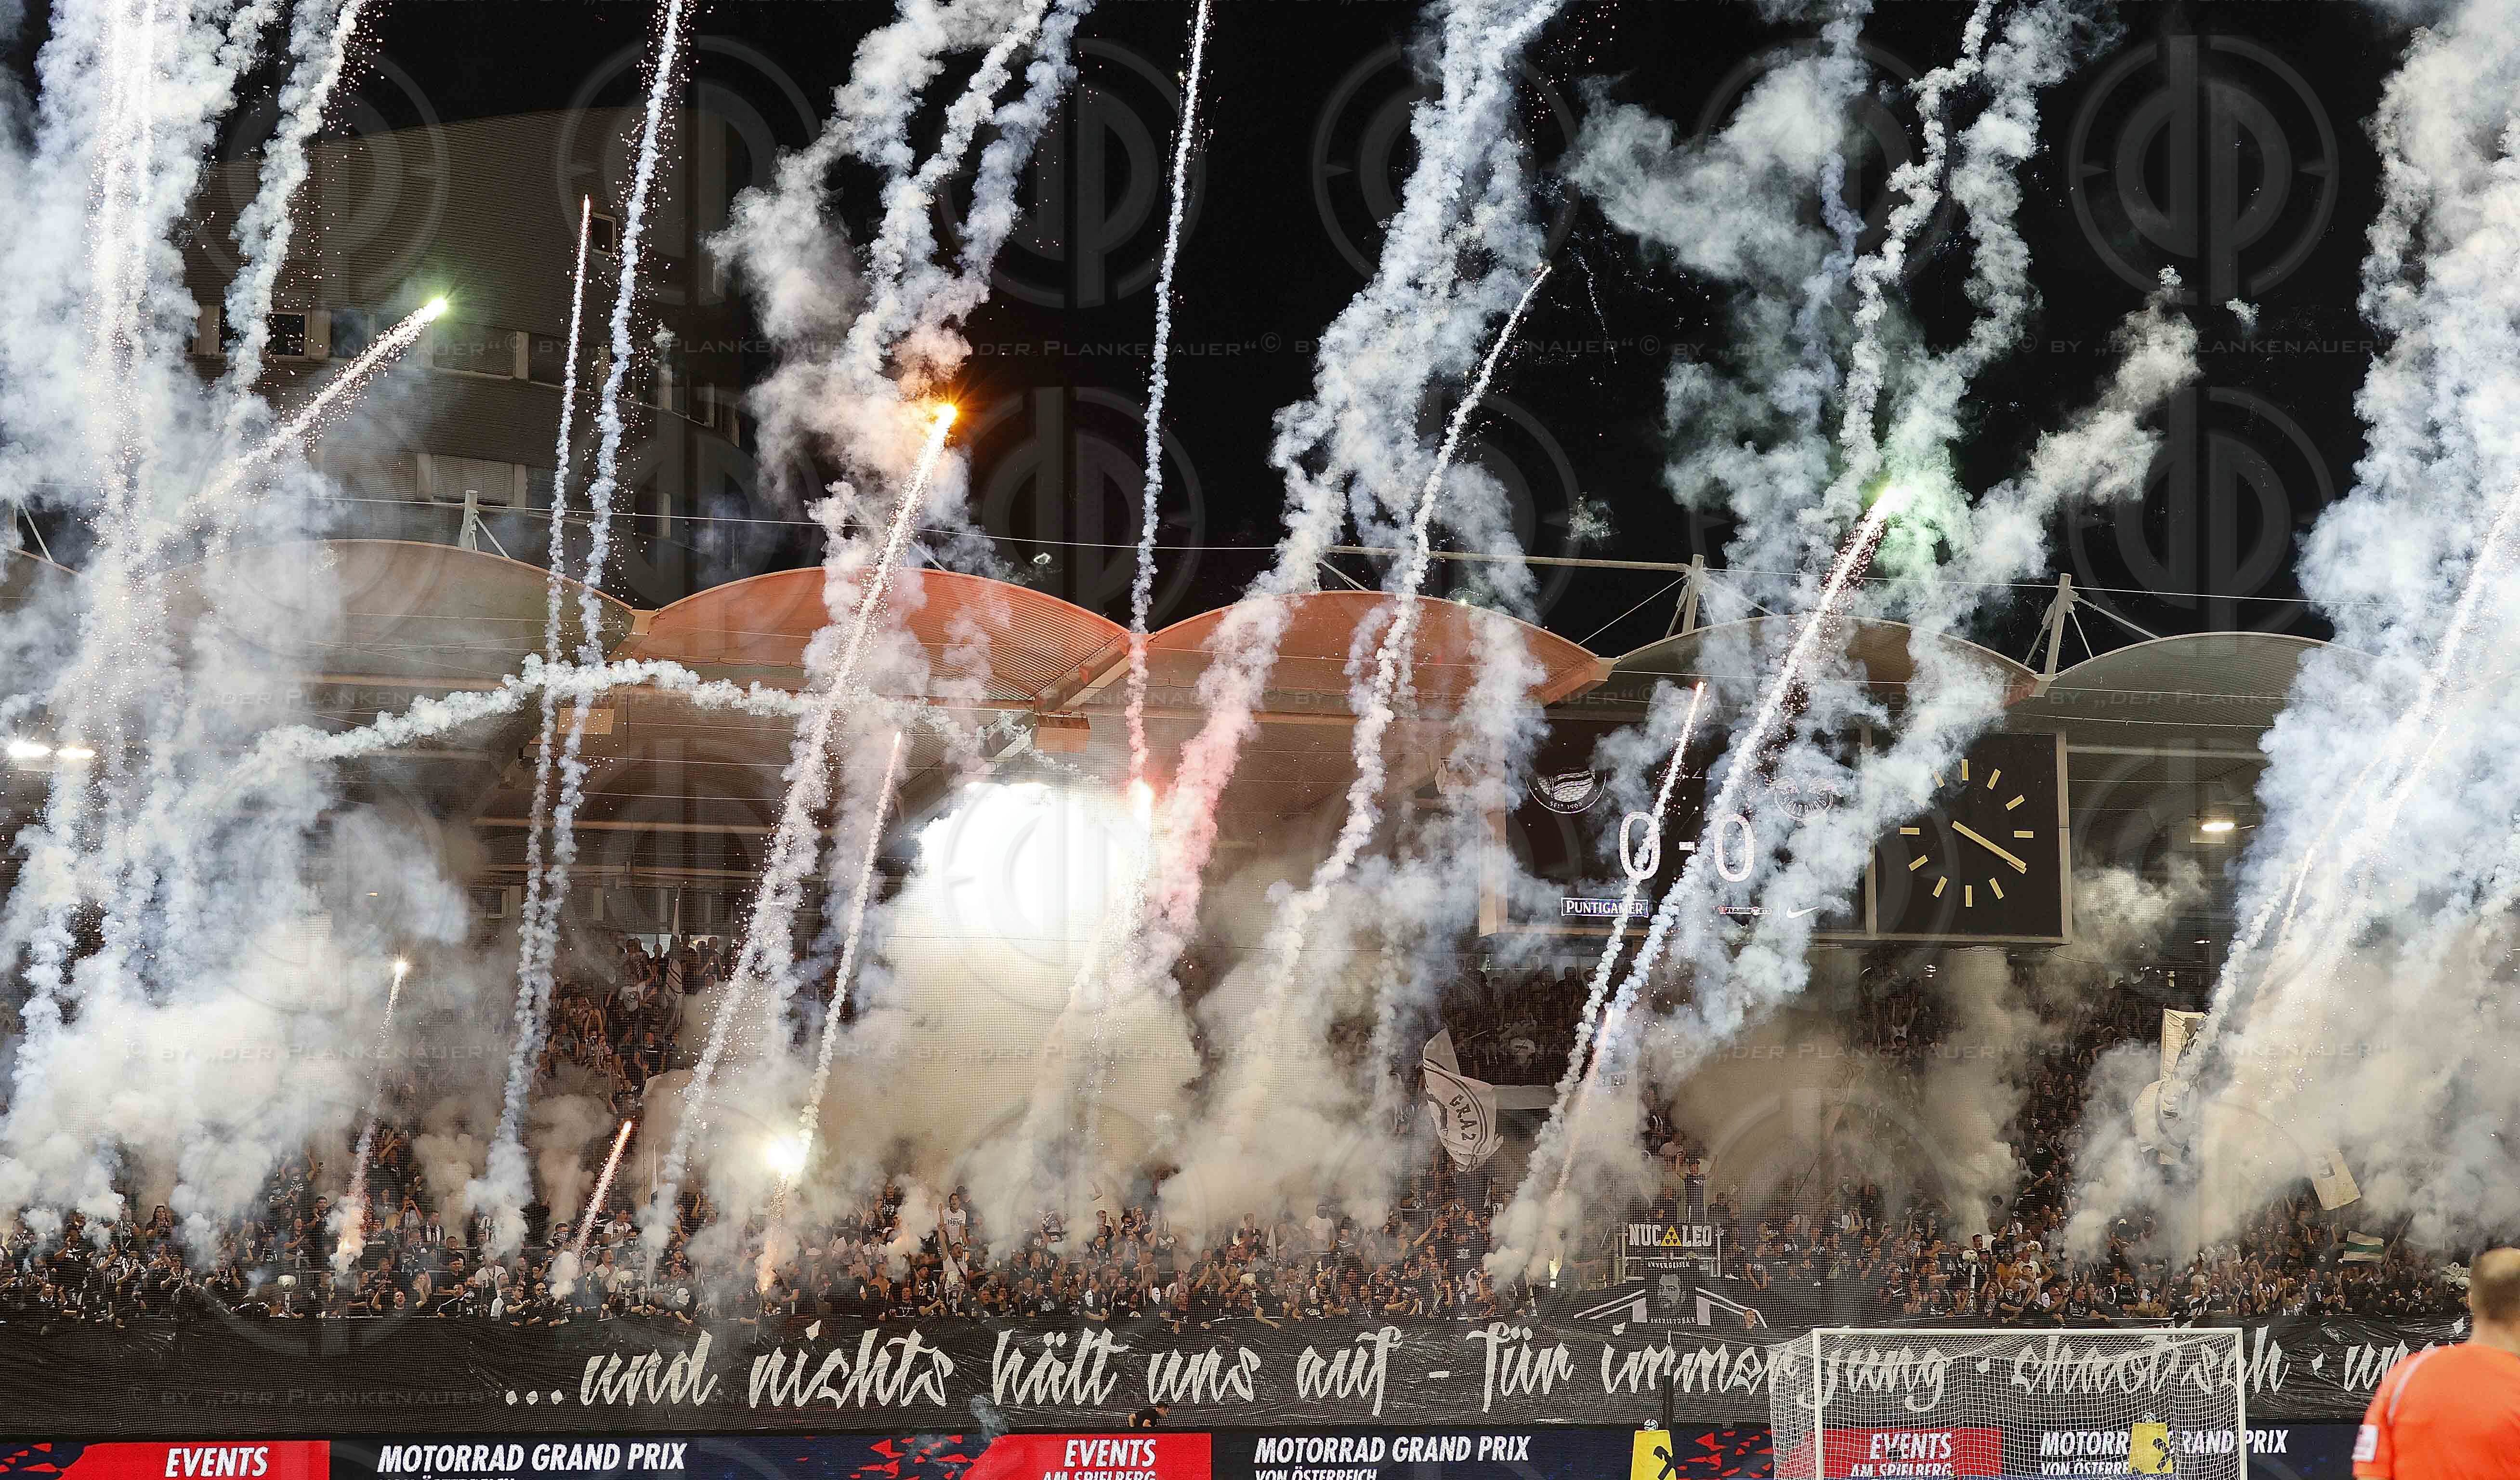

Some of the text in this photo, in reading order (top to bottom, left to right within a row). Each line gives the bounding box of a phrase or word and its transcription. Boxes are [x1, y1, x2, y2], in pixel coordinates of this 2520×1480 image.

[1714, 814, 1754, 882] 0
[749, 1320, 953, 1409] nichts
[993, 1327, 1129, 1405] hält
[1148, 1346, 1260, 1404] uns
[1297, 1326, 1403, 1416] auf
[1063, 1439, 1156, 1467] EVENTS
[1254, 1435, 1532, 1463] MOTORRAD GRAND PRIX
[1871, 1433, 1952, 1459] EVENTS
[2040, 1431, 2129, 1455] MOTORR
[2245, 1429, 2289, 1454] PRIX
[165, 1447, 268, 1477] EVENTS
[377, 1443, 688, 1472] MOTORRAD GRAND PRIX
